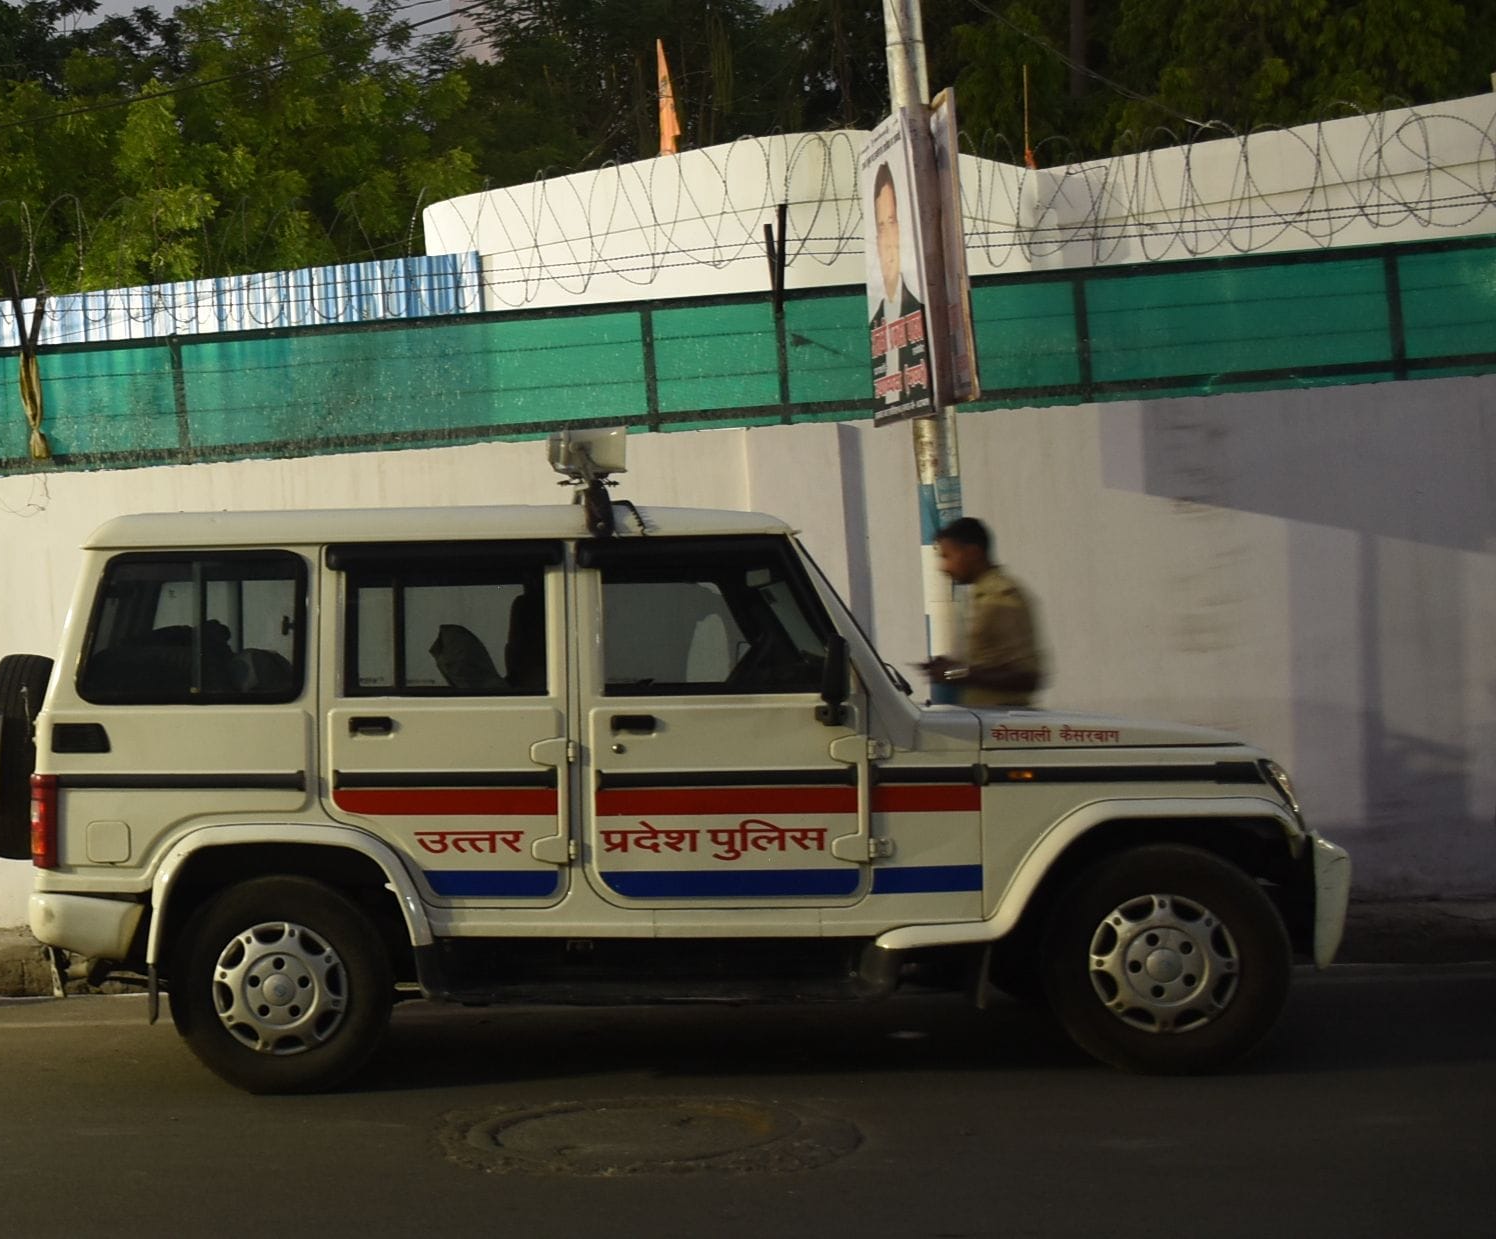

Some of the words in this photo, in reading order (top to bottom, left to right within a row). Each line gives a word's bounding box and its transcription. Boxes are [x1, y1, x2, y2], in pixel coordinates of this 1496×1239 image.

[990, 724, 1052, 742] कोतवाली
[1058, 723, 1120, 743] कैसरबाग
[415, 829, 525, 854] उत्तर
[599, 821, 700, 853] प्रदेश
[707, 818, 827, 861] पुलिस
